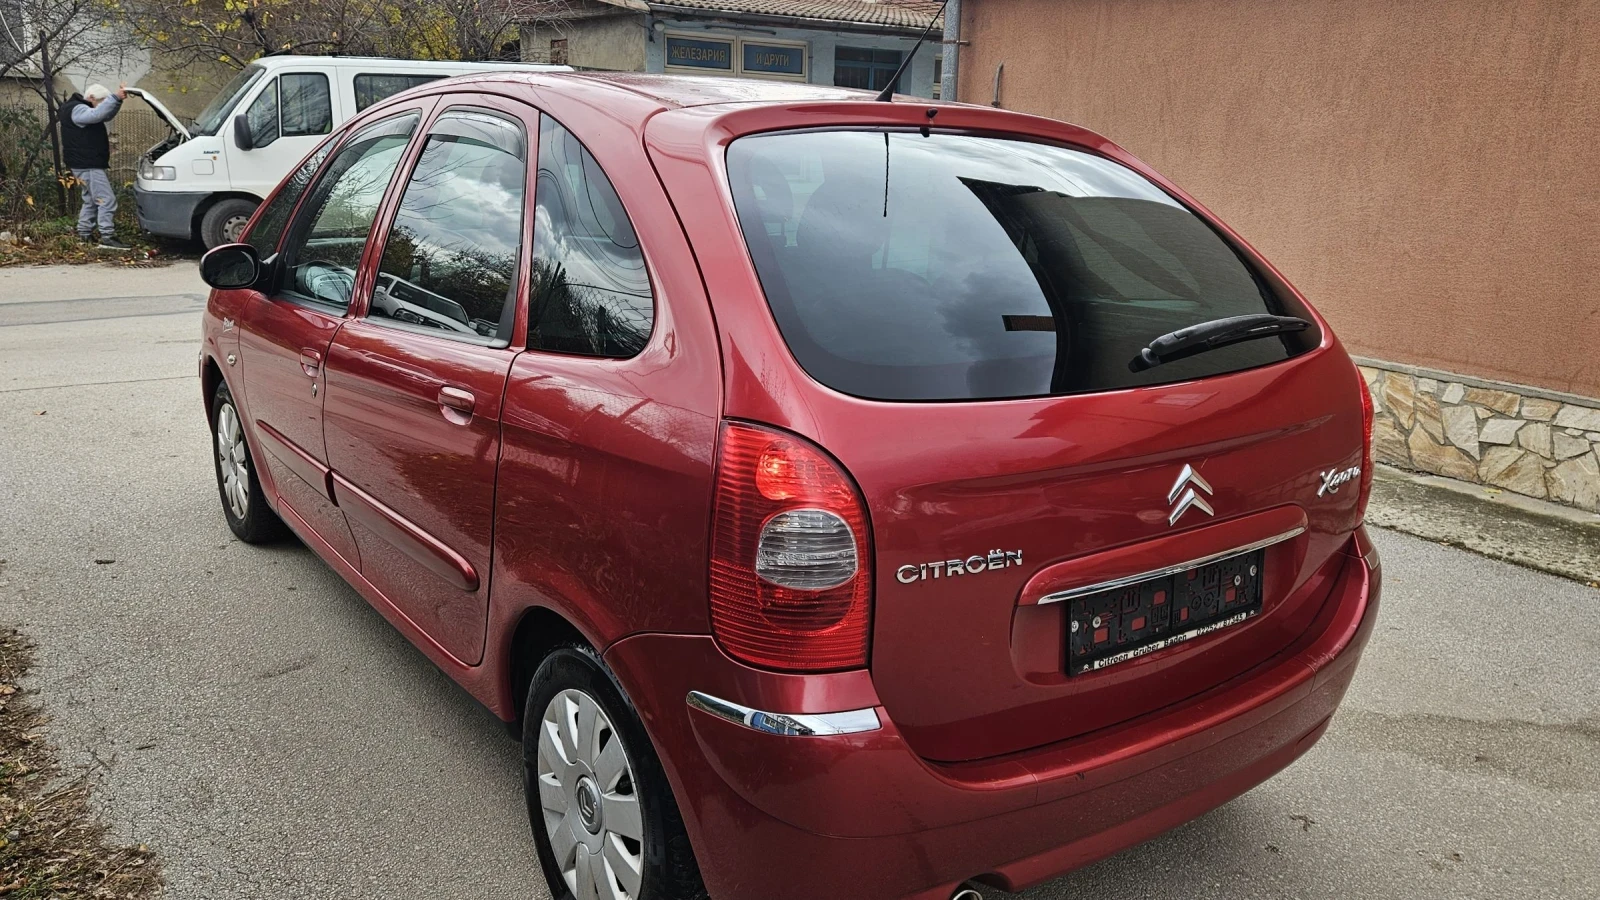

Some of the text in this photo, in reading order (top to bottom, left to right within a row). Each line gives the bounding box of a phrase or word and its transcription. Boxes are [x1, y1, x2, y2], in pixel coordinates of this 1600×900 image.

[671, 45, 726, 62] ЖЕЛЕЗАРИЯ
[756, 52, 789, 66] И ДРУГИ
[896, 548, 1023, 584] CITROËN
[1133, 643, 1160, 656] Gruber
[1165, 634, 1187, 647] Baden
